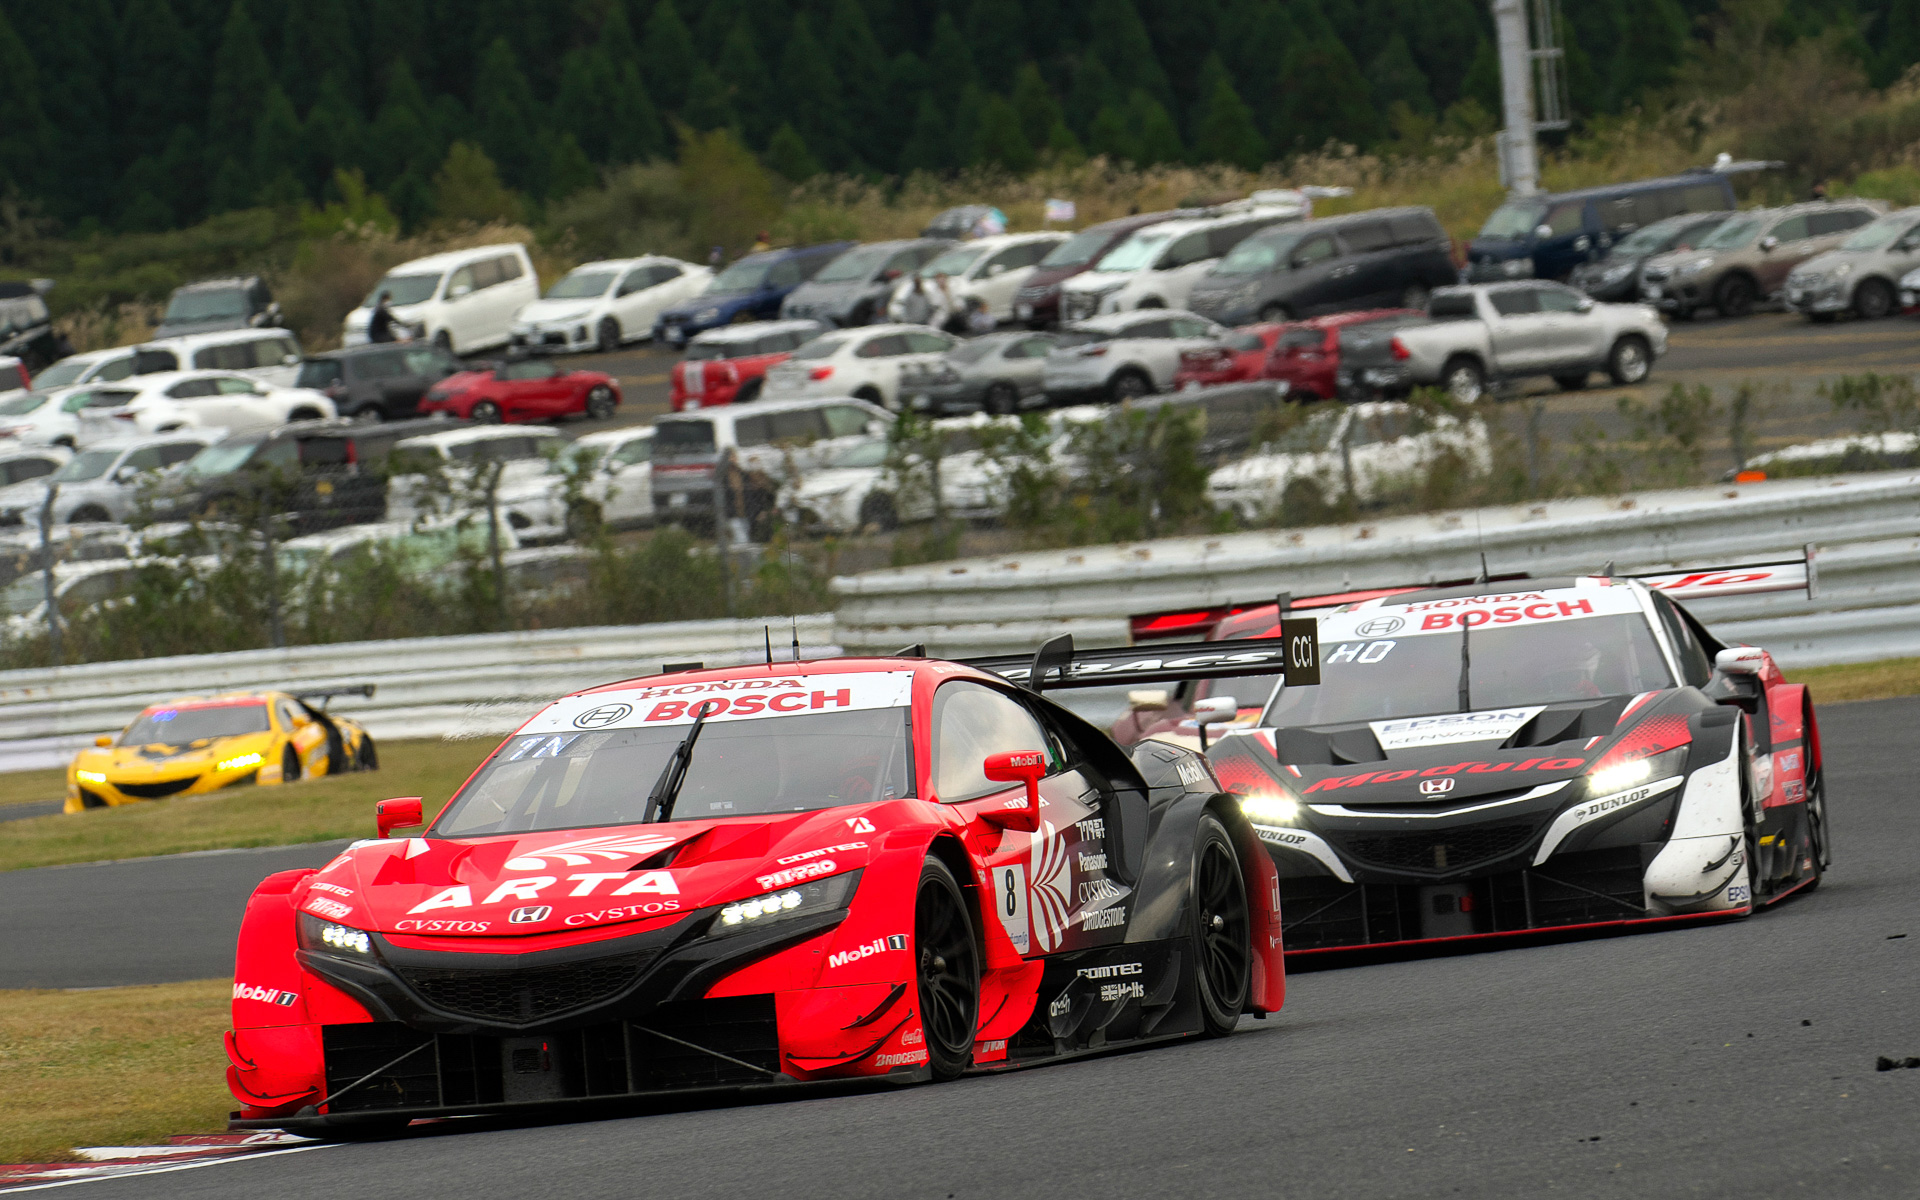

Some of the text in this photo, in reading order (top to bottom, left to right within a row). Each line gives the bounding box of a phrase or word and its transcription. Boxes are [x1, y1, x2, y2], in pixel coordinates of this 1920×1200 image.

[1404, 593, 1548, 614] HONDA
[1421, 599, 1594, 631] BOSCH
[1292, 635, 1313, 668] CCi
[636, 679, 805, 700] HONDA
[643, 688, 850, 722] BOSCH
[1383, 712, 1526, 732] EPSON
[1389, 729, 1511, 745] KENWOOD
[1010, 755, 1037, 767] Mobil
[1301, 756, 1586, 794] Modulo
[1588, 788, 1649, 815] DUNLOP
[777, 842, 868, 865] COMTEC
[1078, 849, 1108, 872] Panasonic
[406, 871, 680, 914] ARTA
[1005, 869, 1016, 916] 8
[1078, 878, 1120, 903] CVSTOS
[394, 919, 491, 932] CVSTOS
[564, 900, 680, 926] CVSTOS
[1081, 906, 1126, 932] BRIDGESTONE
[828, 938, 886, 968] Mobil
[1077, 962, 1142, 979] COMTEC
[875, 1049, 927, 1067] BRIDGESTONE
